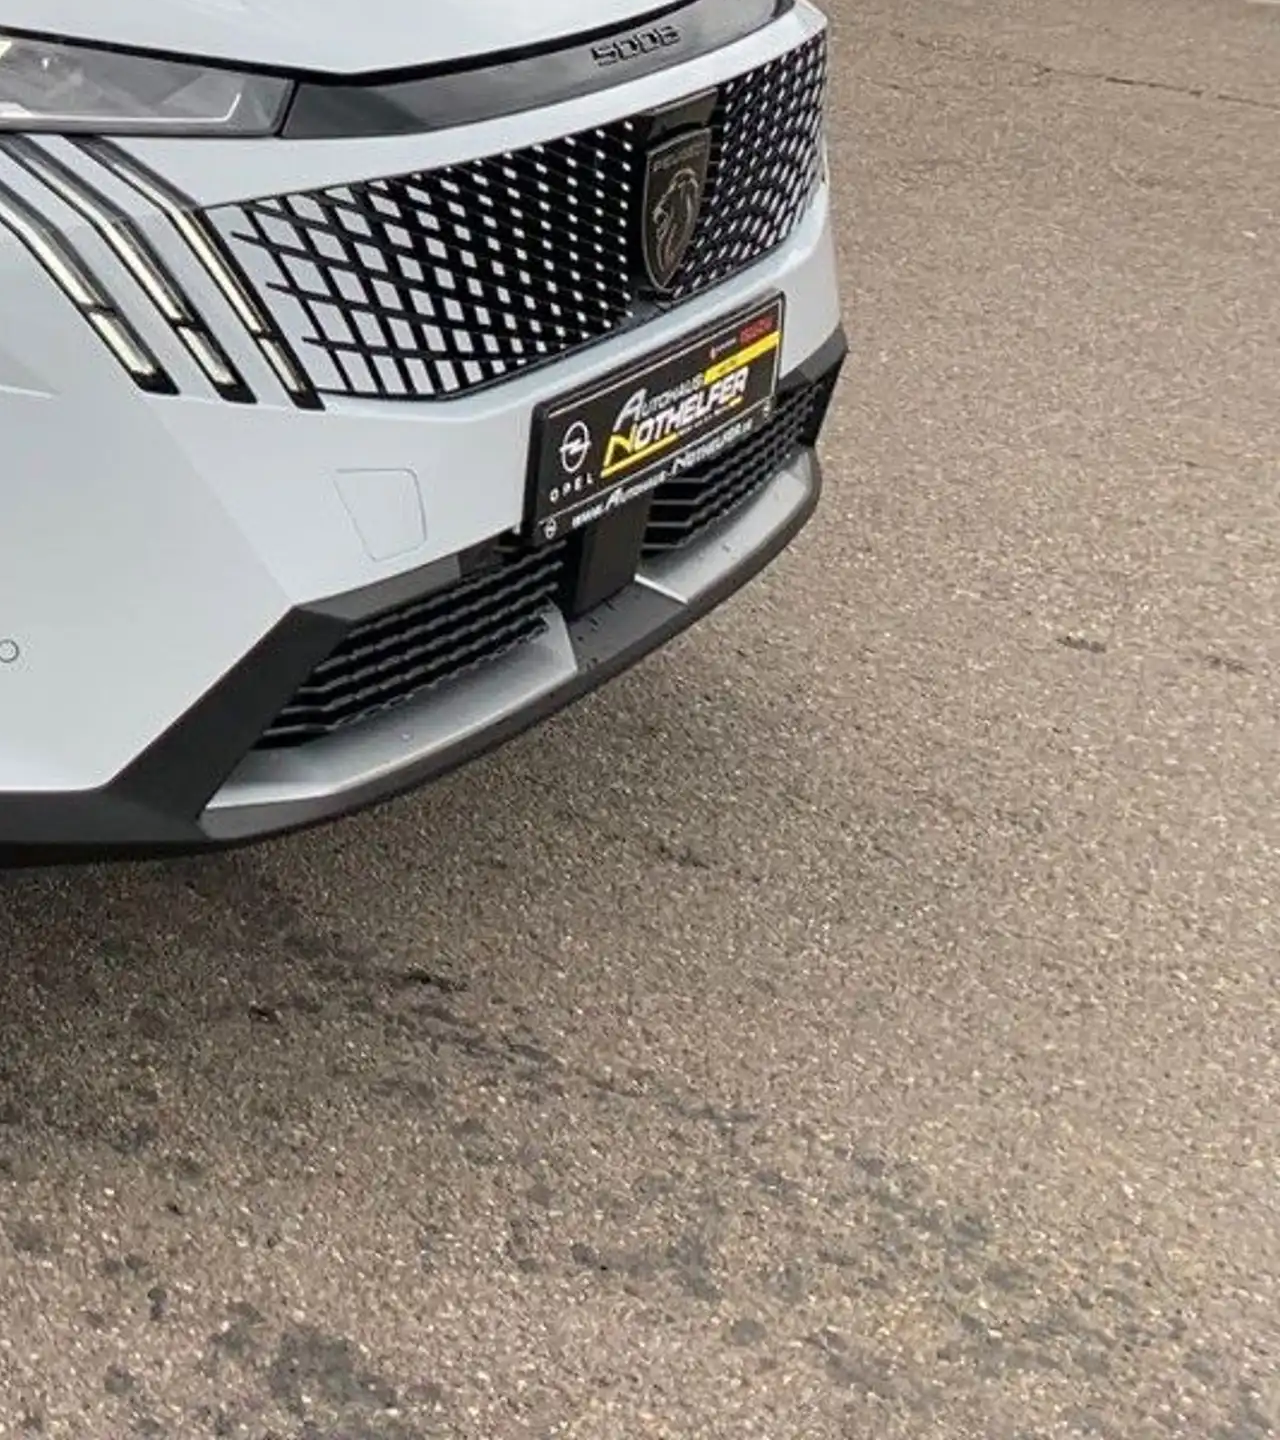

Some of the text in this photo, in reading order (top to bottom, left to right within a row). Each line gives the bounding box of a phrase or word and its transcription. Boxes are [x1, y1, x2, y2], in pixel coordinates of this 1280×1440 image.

[603, 366, 749, 468] NOTHELFER
[612, 371, 705, 432] AUTOHAUS
[549, 472, 594, 503] OPEL
